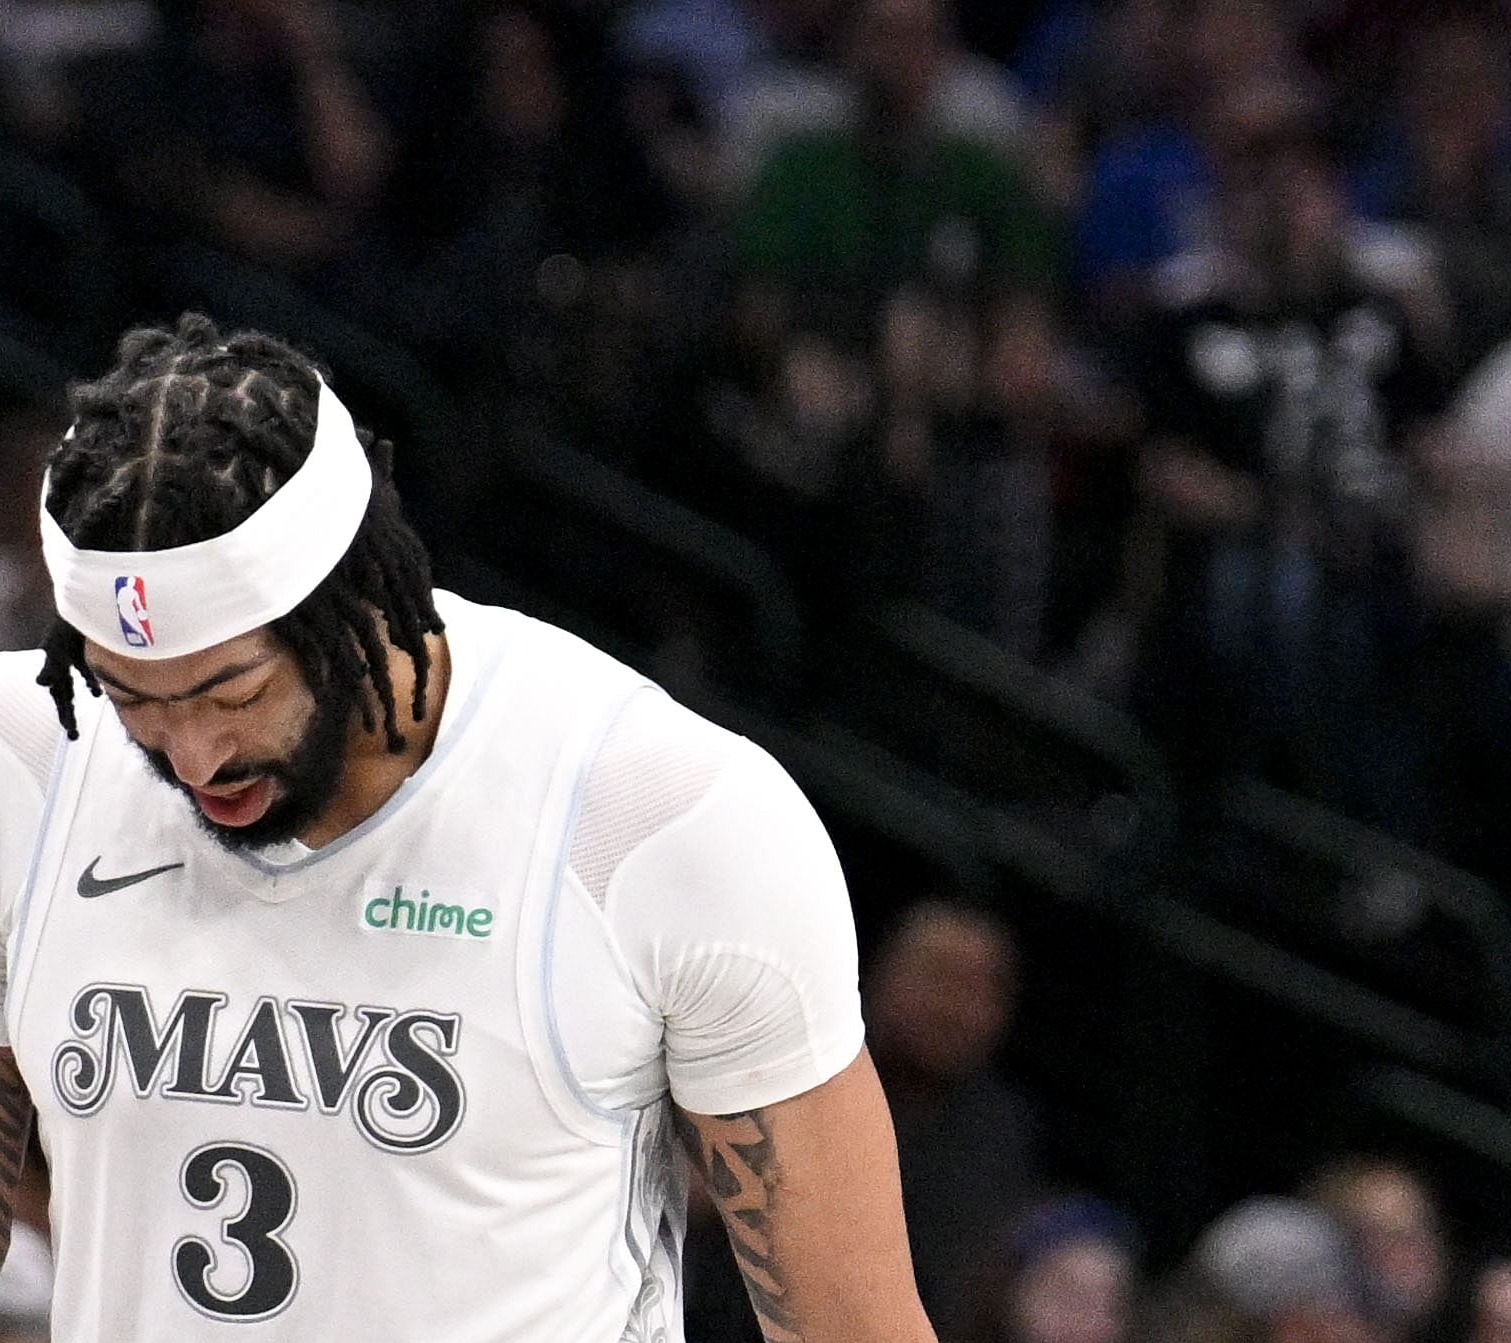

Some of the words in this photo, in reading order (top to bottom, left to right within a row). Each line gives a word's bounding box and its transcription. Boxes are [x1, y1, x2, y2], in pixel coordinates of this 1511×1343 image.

[365, 885, 494, 938] chime
[51, 982, 467, 1156] MAVS
[171, 1140, 301, 1324] 3
